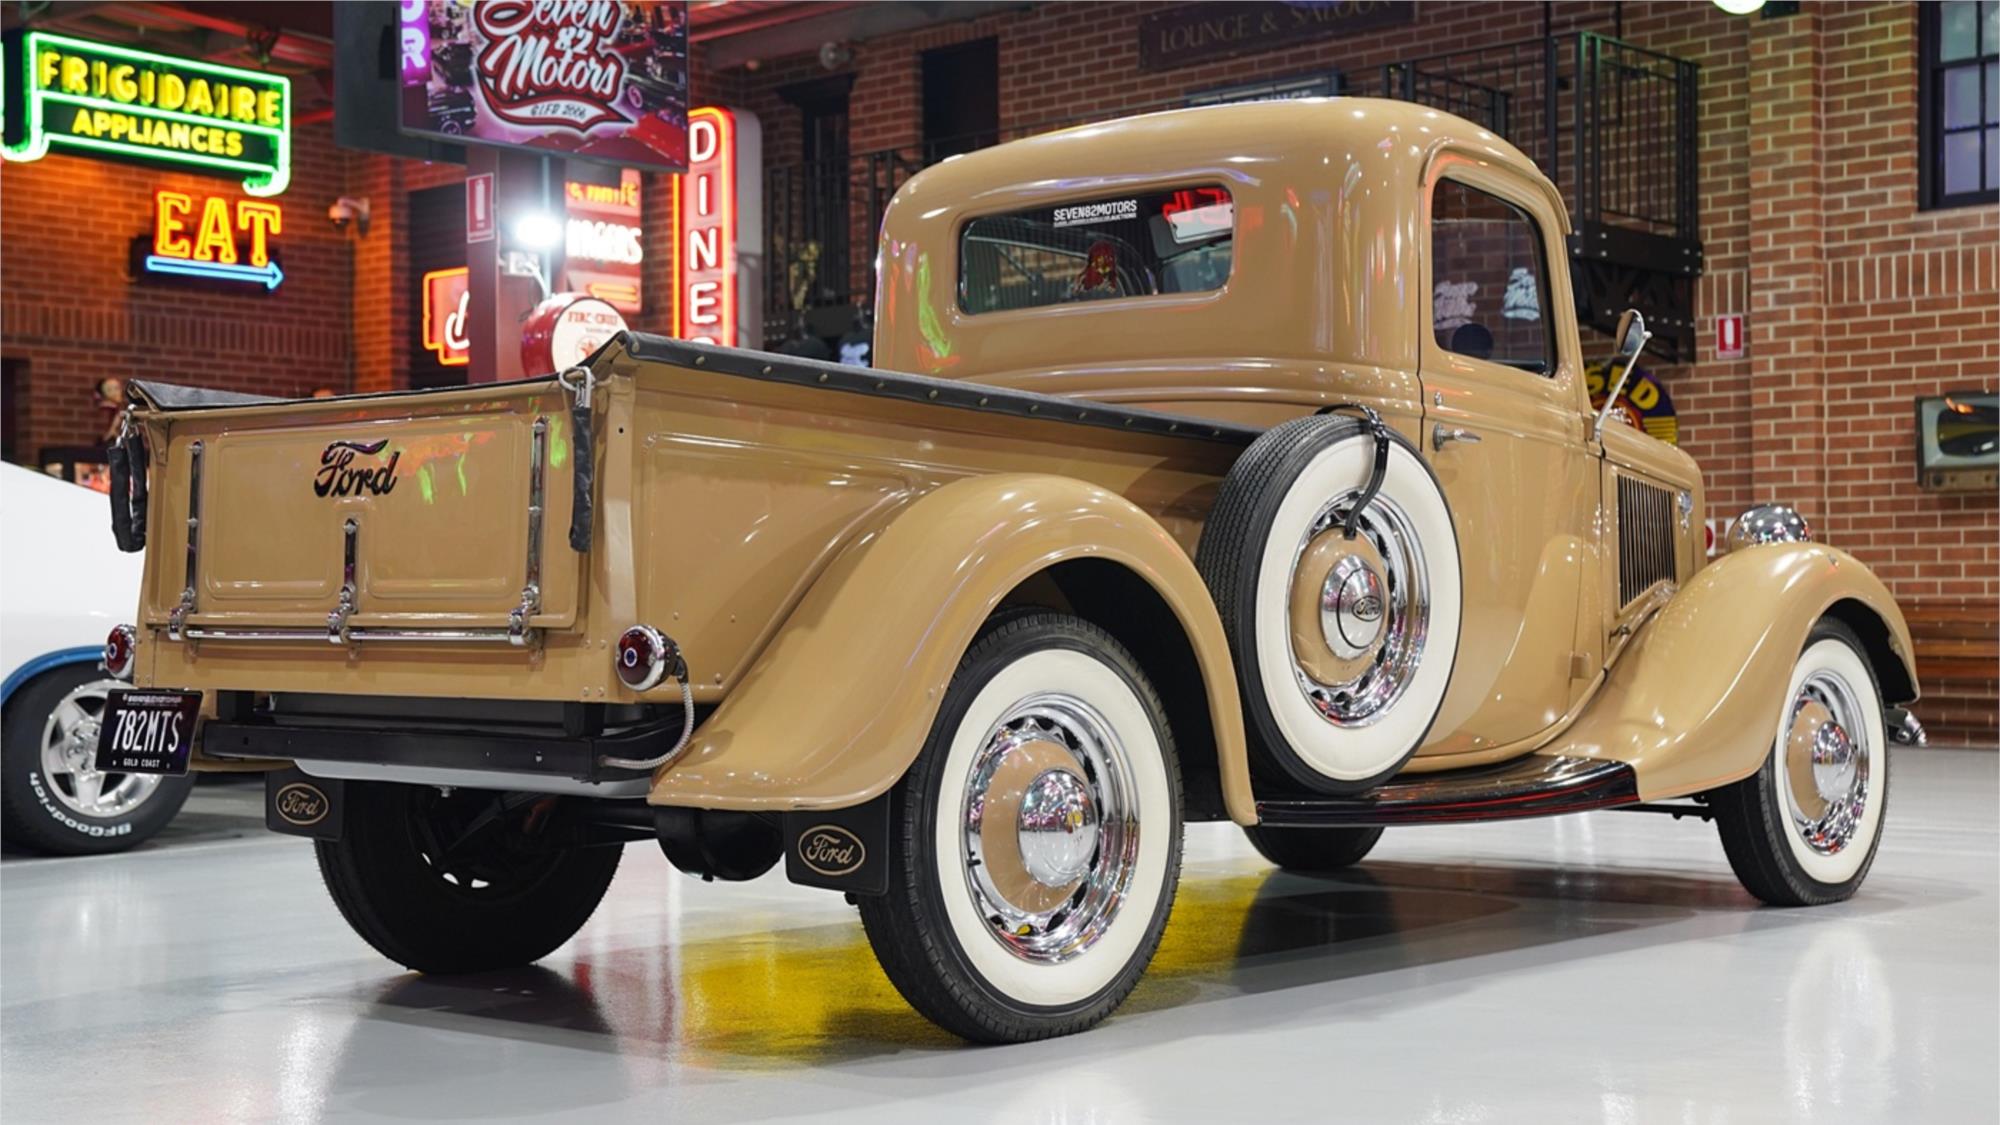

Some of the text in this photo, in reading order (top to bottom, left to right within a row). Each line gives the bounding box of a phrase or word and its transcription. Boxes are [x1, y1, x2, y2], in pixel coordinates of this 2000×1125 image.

[554, 26, 593, 54] 82
[1160, 15, 1248, 52] LOUNGE
[1259, 14, 1279, 34] &
[484, 33, 618, 97] Motors
[39, 51, 282, 126] FRIGIDAIRE
[71, 109, 244, 157] APPLIANCES
[155, 191, 282, 267] EAT
[1054, 199, 1137, 221] SEVEN82MOTORS
[314, 438, 401, 497] Ford
[112, 709, 184, 753] 782MTS
[123, 758, 160, 768] GOLD COAST
[30, 771, 132, 837] BFGoodrich
[281, 789, 321, 816] Ford
[805, 833, 855, 864] Ford
